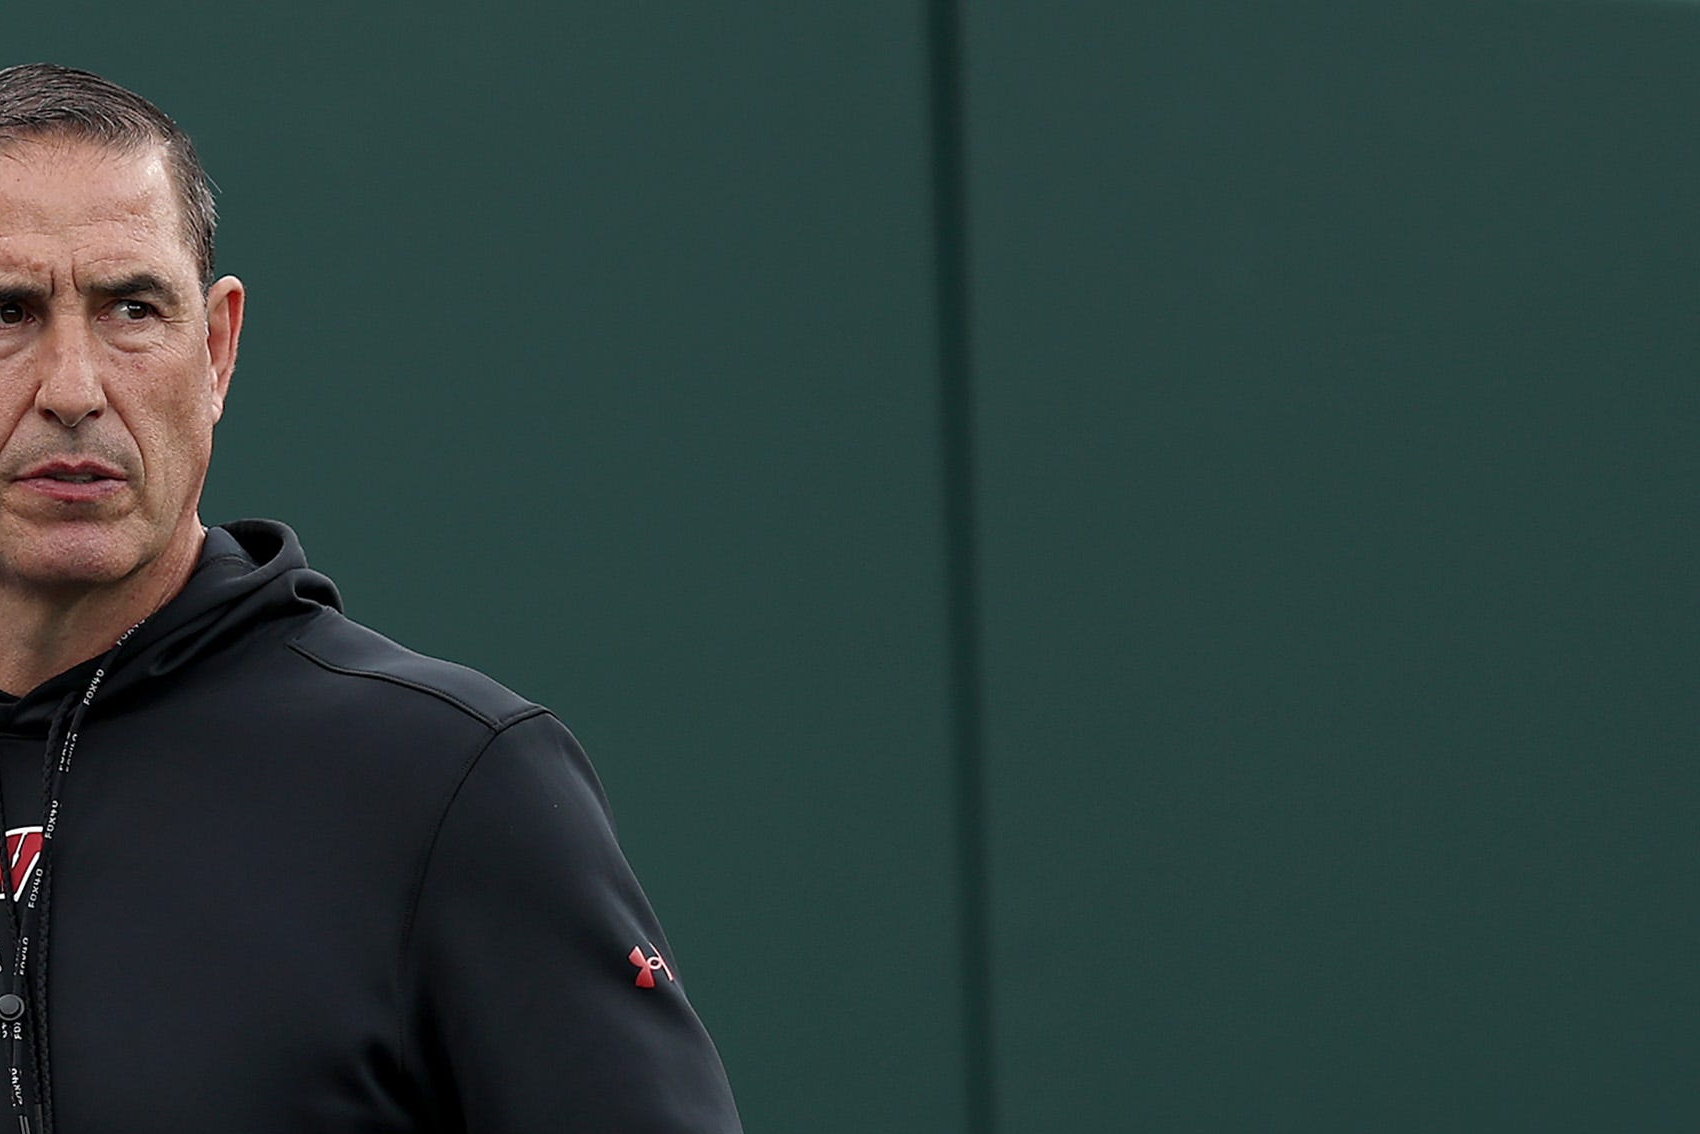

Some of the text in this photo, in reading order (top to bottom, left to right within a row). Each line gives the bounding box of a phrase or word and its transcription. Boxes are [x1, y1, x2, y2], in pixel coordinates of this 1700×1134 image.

[83, 668, 105, 706] FOX40
[44, 800, 60, 839] FOX40
[27, 868, 44, 909] FOX40
